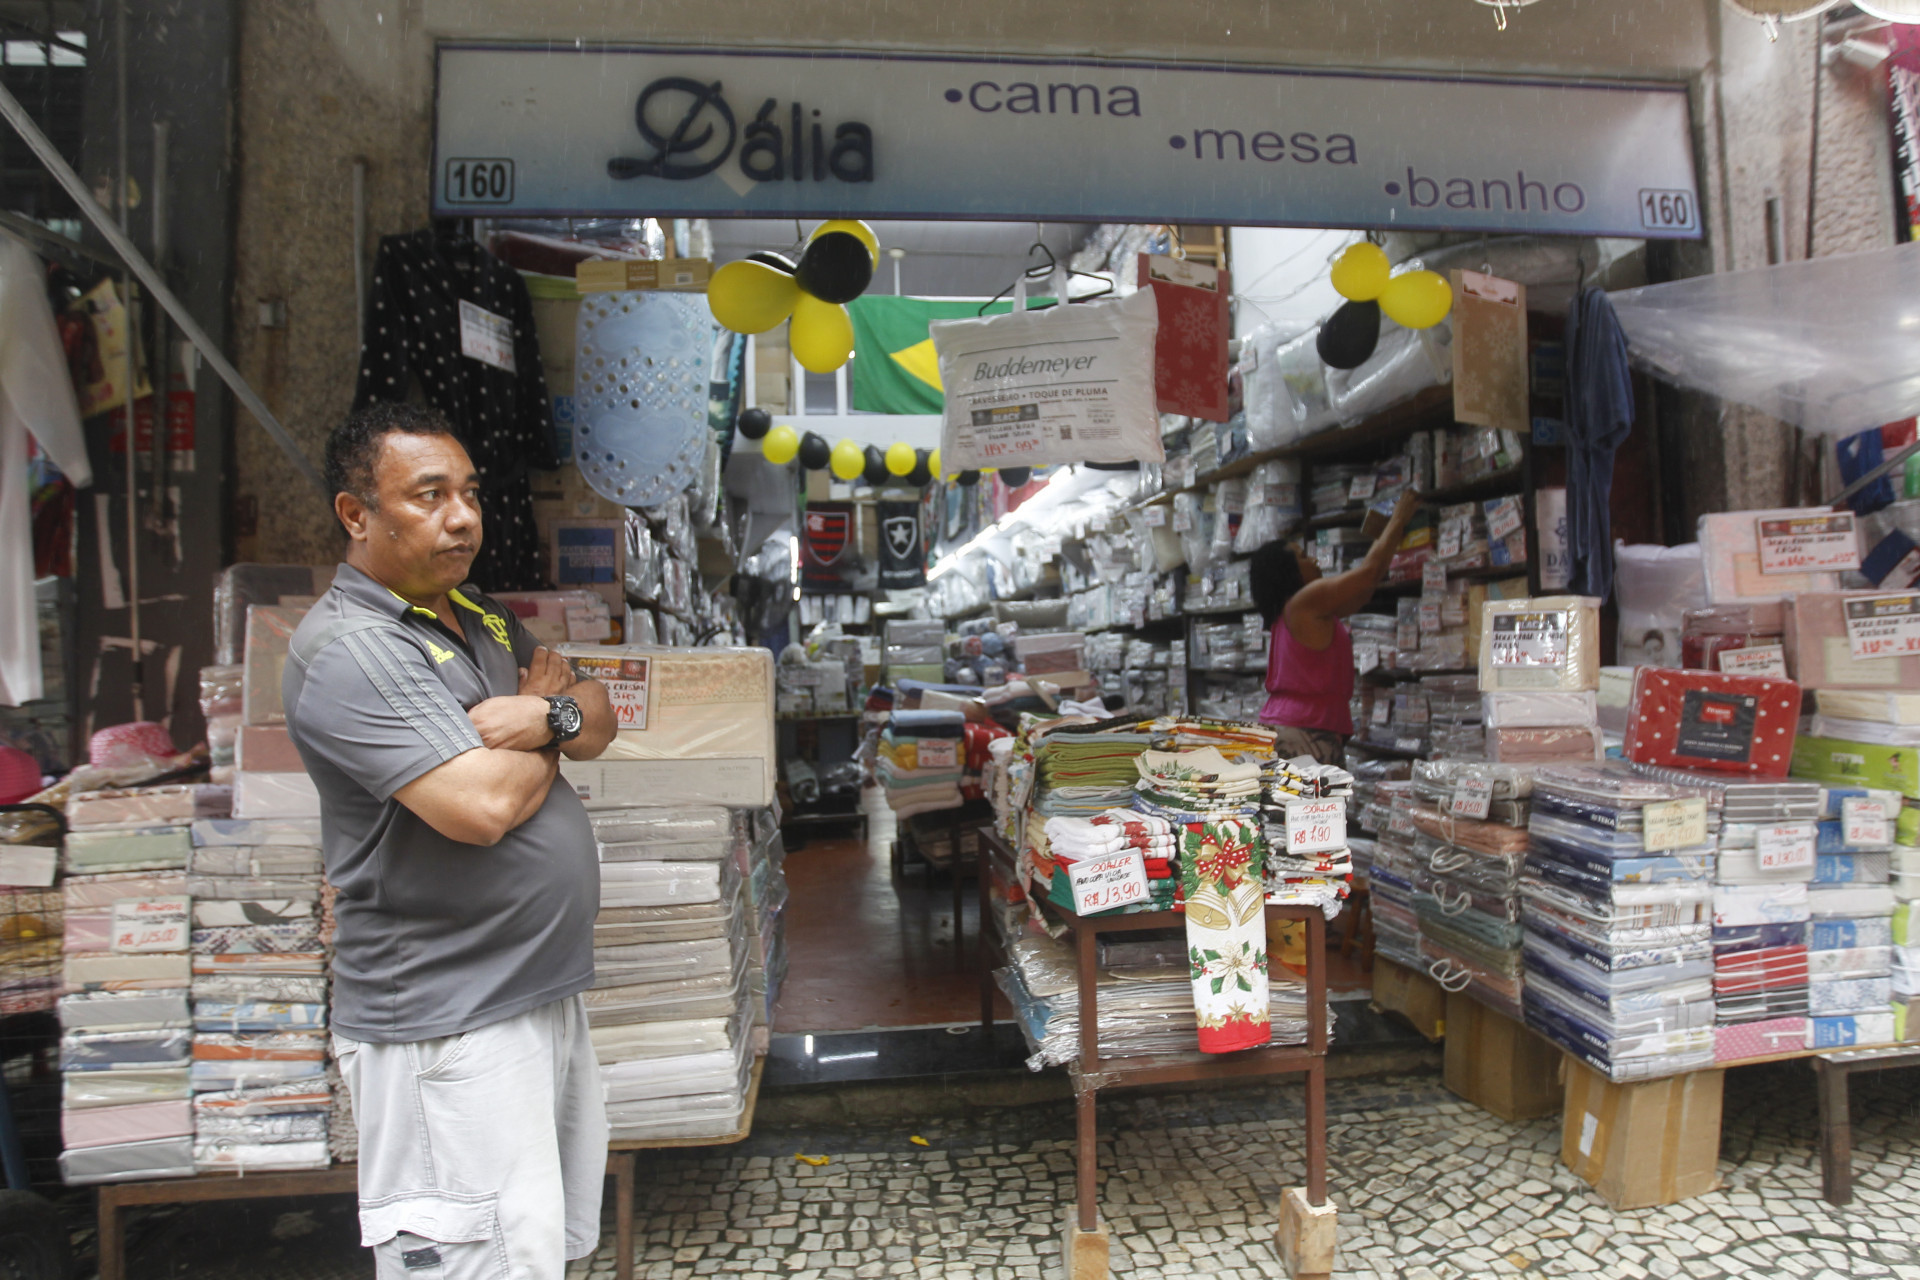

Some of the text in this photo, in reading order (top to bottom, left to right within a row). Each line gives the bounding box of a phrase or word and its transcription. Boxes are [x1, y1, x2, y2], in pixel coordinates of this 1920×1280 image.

[969, 81, 1142, 117] cama
[607, 76, 874, 184] Dália
[1193, 127, 1358, 165] mesa
[451, 162, 507, 199] 160
[1406, 167, 1586, 213] banho
[1645, 193, 1688, 226] 160
[973, 355, 1098, 382] Buddemeyer
[1028, 390, 1059, 400] TOQUE
[1062, 388, 1073, 397] DE
[1075, 387, 1108, 397] PLUMA
